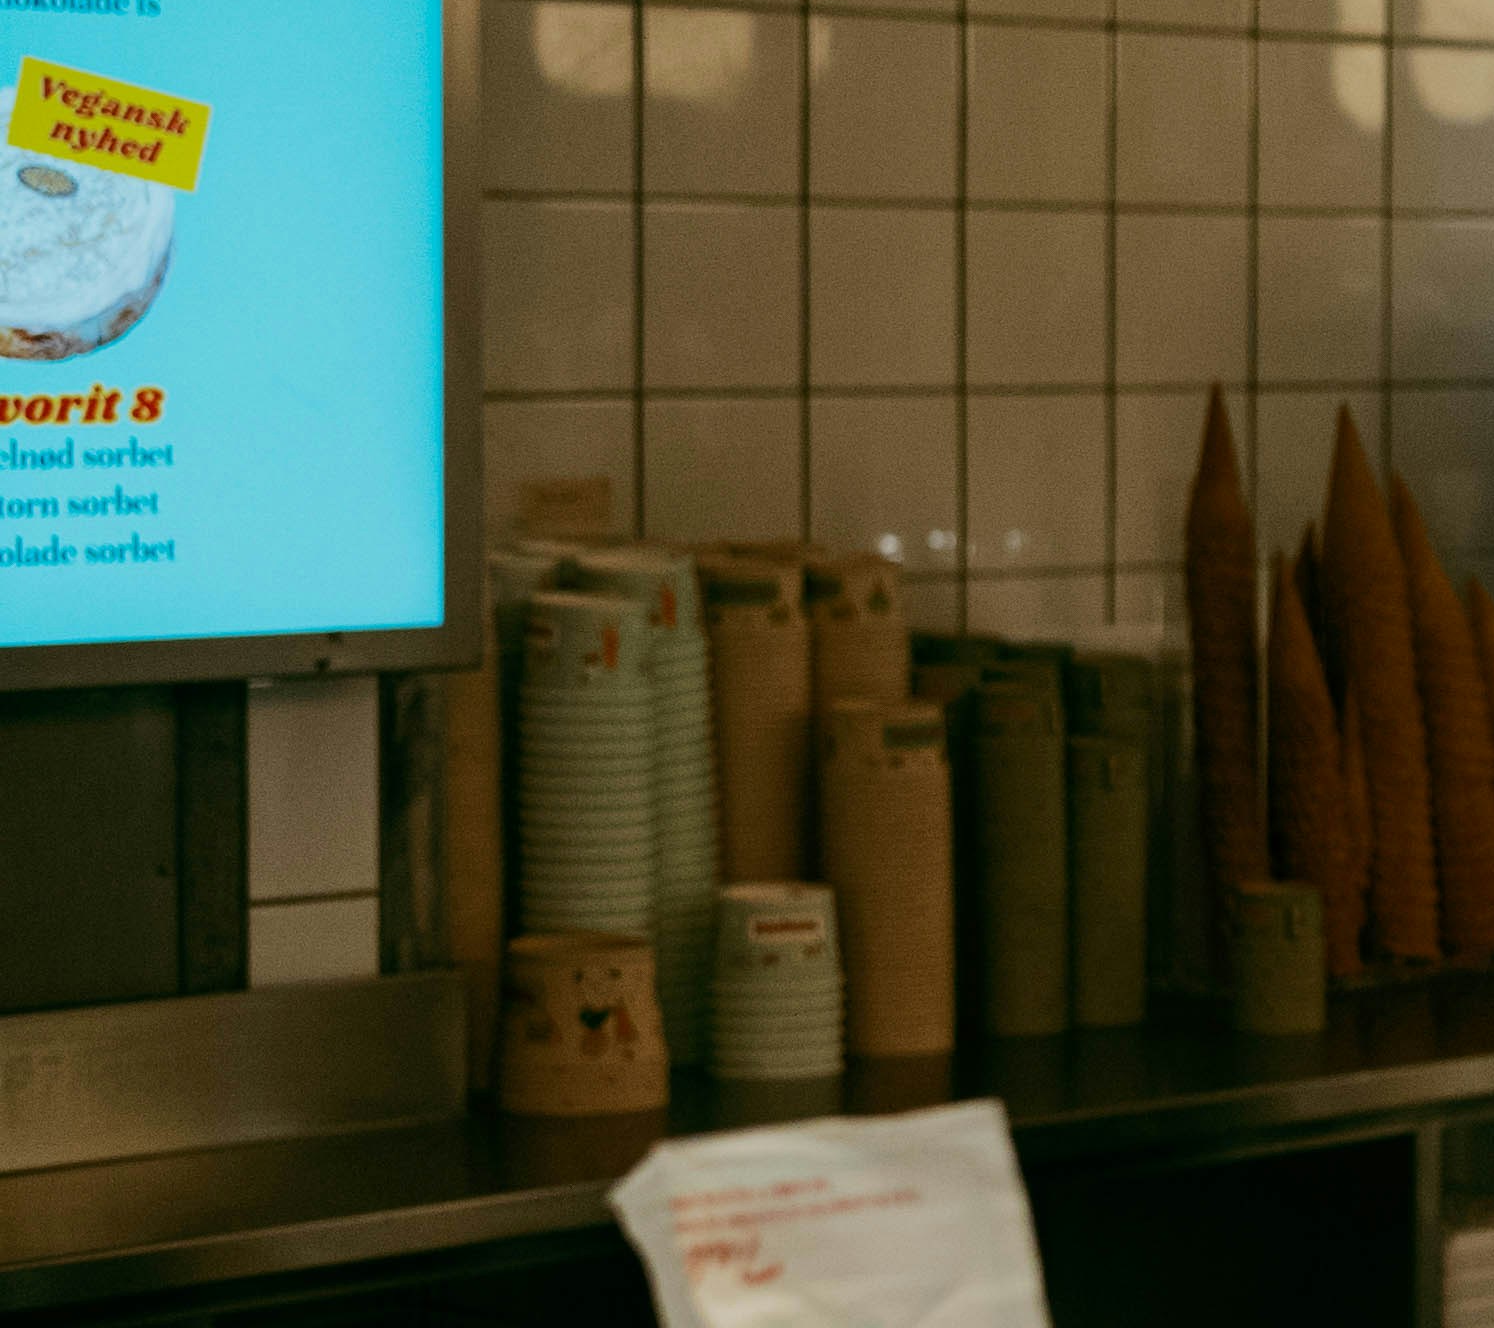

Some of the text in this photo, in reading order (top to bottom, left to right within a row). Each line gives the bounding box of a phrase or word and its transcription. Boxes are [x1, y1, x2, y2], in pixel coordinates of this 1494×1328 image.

[41, 74, 190, 137] Vegansk
[50, 120, 163, 165] nyhed
[131, 387, 165, 423] 8
[83, 435, 173, 467] sorbet
[68, 484, 158, 515] sorbet
[85, 531, 174, 563] sorbet
